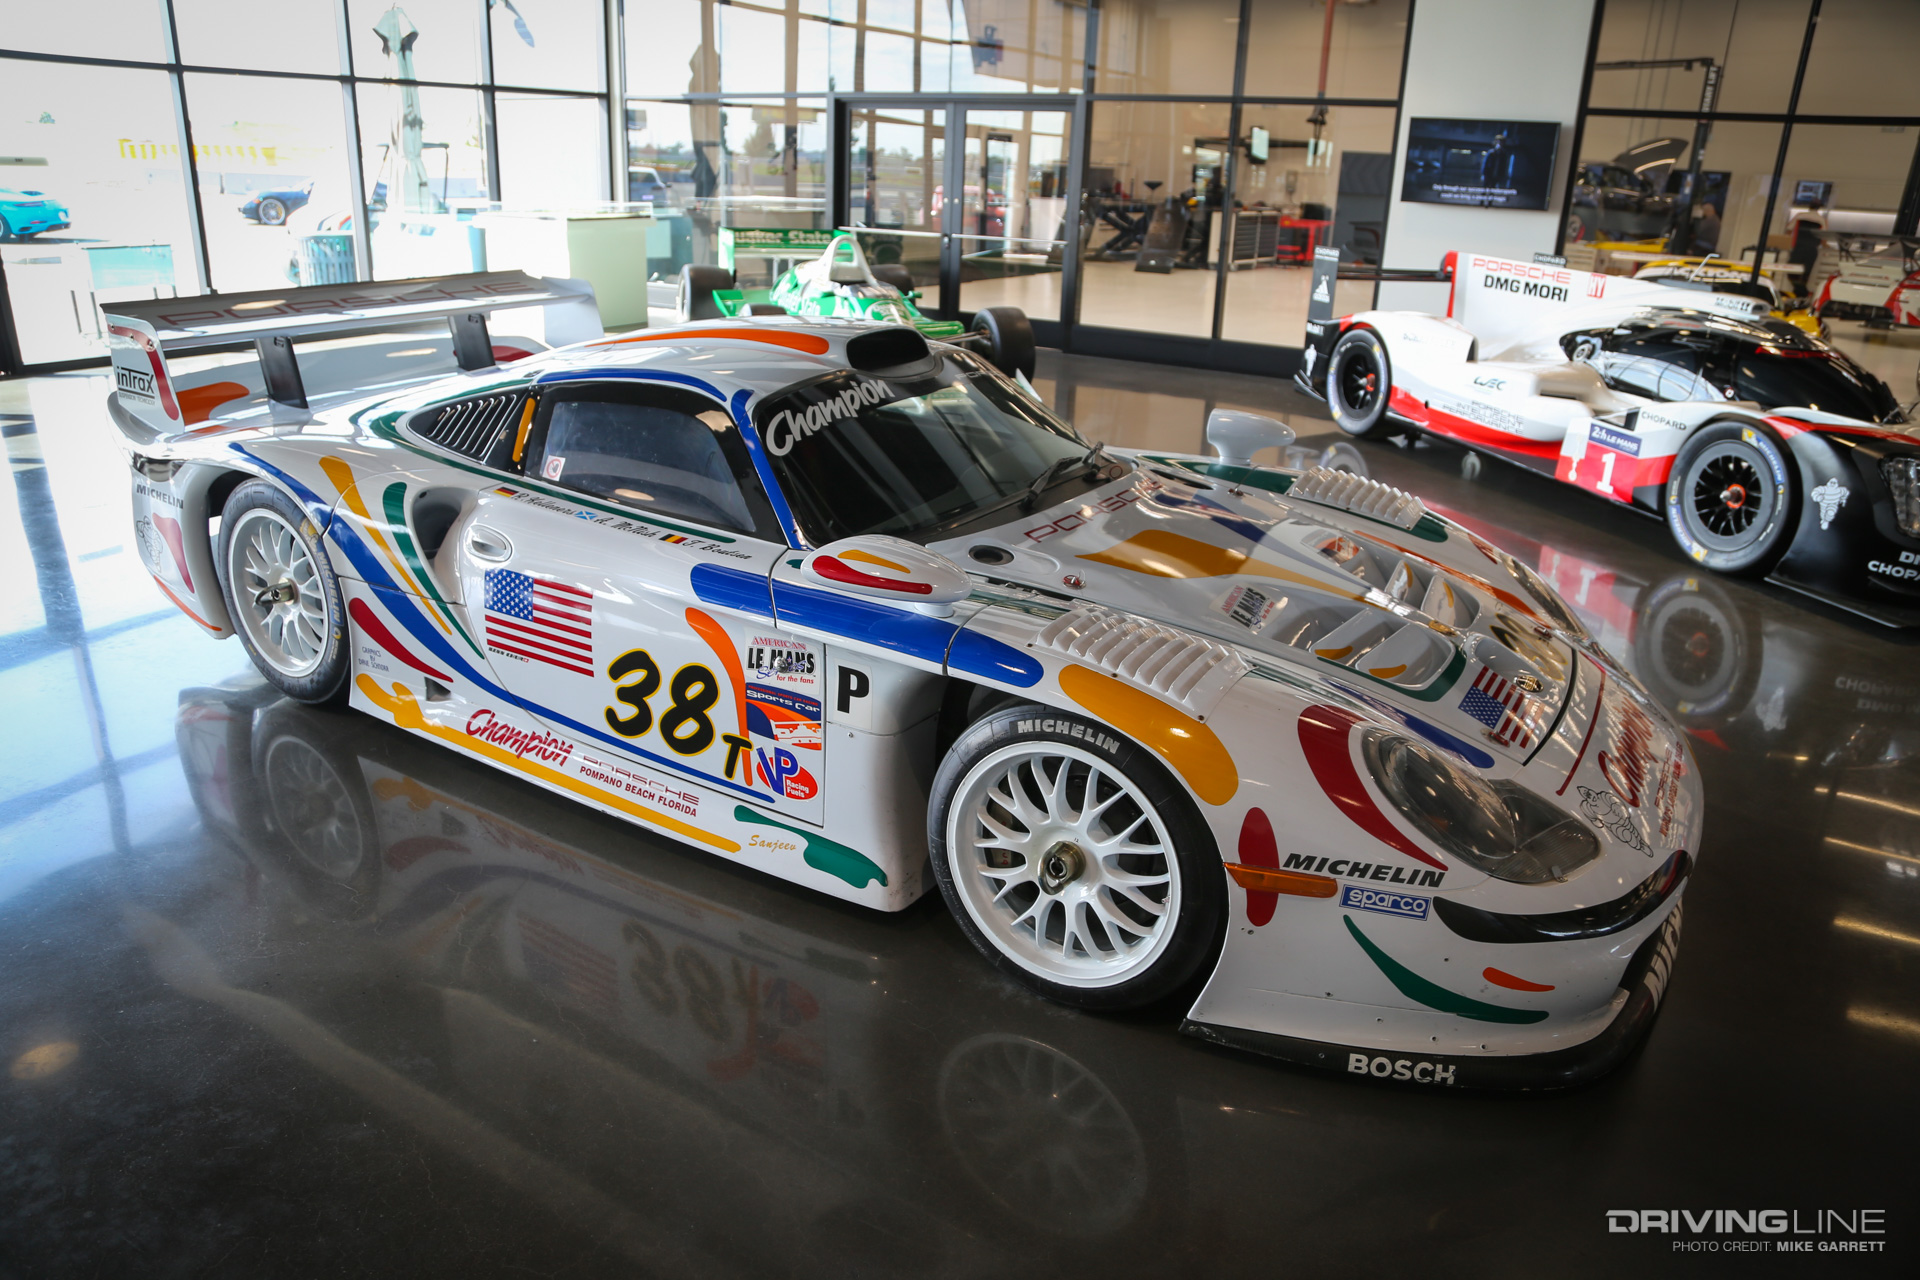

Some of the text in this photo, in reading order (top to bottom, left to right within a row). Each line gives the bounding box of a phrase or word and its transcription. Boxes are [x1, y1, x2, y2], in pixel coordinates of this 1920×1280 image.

[1473, 258, 1572, 285] PORSCHE
[157, 281, 534, 326] PORSCHE
[1484, 274, 1568, 302] DMG MORI
[765, 379, 895, 457] Champion
[1641, 411, 1687, 431] CHOPARD
[1596, 452, 1616, 494] 1
[136, 484, 184, 509] MICHELIN
[317, 551, 342, 623] MICHELIN
[752, 635, 807, 651] AMERICAN
[747, 647, 815, 674] LE MANS
[800, 676, 814, 685] fans
[837, 665, 870, 714] P
[604, 648, 720, 757] 38
[747, 689, 820, 713] Sports Car
[466, 709, 574, 768] Champion
[1017, 719, 1121, 755] MICHELIN
[583, 755, 700, 806] PORSCHE
[756, 746, 799, 796] VP
[787, 780, 809, 793] Racing
[580, 765, 698, 817] POMPANO BEACH FLORIDA
[787, 787, 805, 798] Fuels
[748, 834, 797, 853] Sanjeev
[1283, 852, 1446, 888] MICHELIN
[1349, 889, 1427, 912] sparco
[1347, 1053, 1456, 1085] BOSCH
